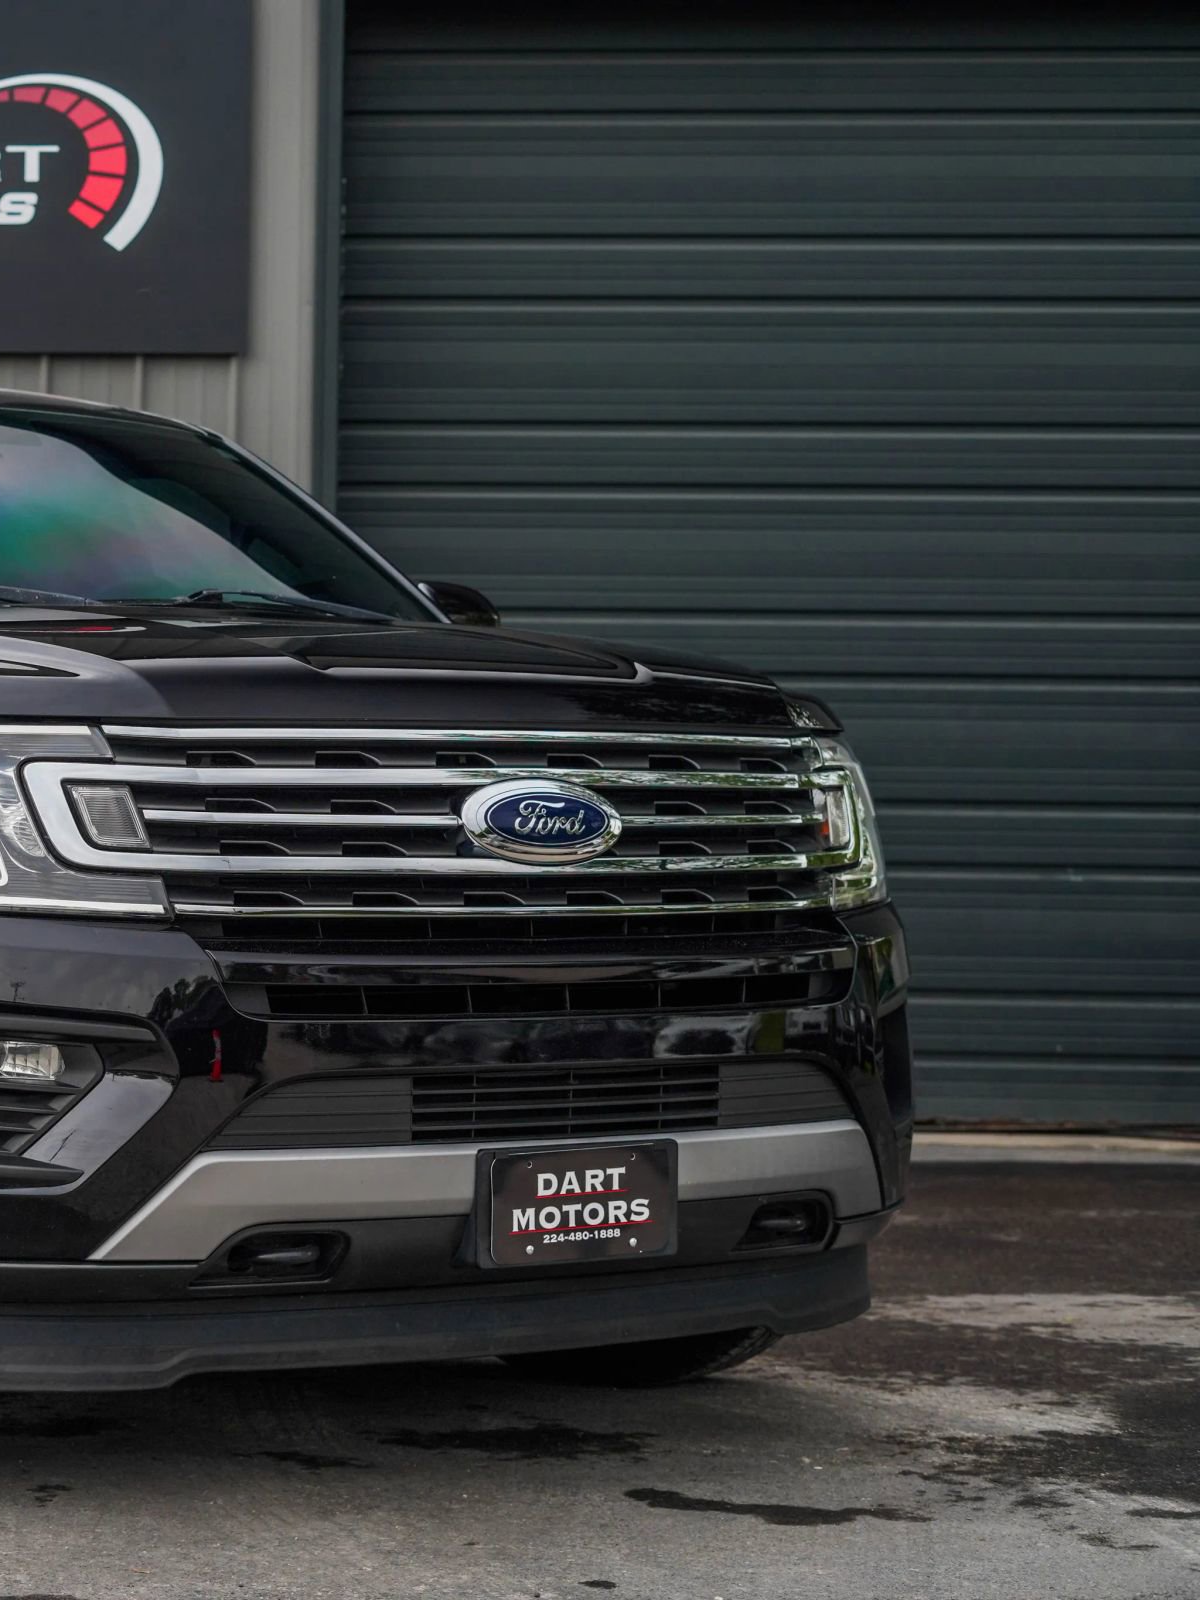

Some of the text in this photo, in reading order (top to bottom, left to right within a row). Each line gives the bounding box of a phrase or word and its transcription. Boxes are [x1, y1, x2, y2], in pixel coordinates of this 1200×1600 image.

[514, 800, 586, 835] Ford
[536, 1165, 626, 1197] DART
[512, 1198, 650, 1233] MOTORS
[543, 1228, 621, 1244] 224-480-1888
